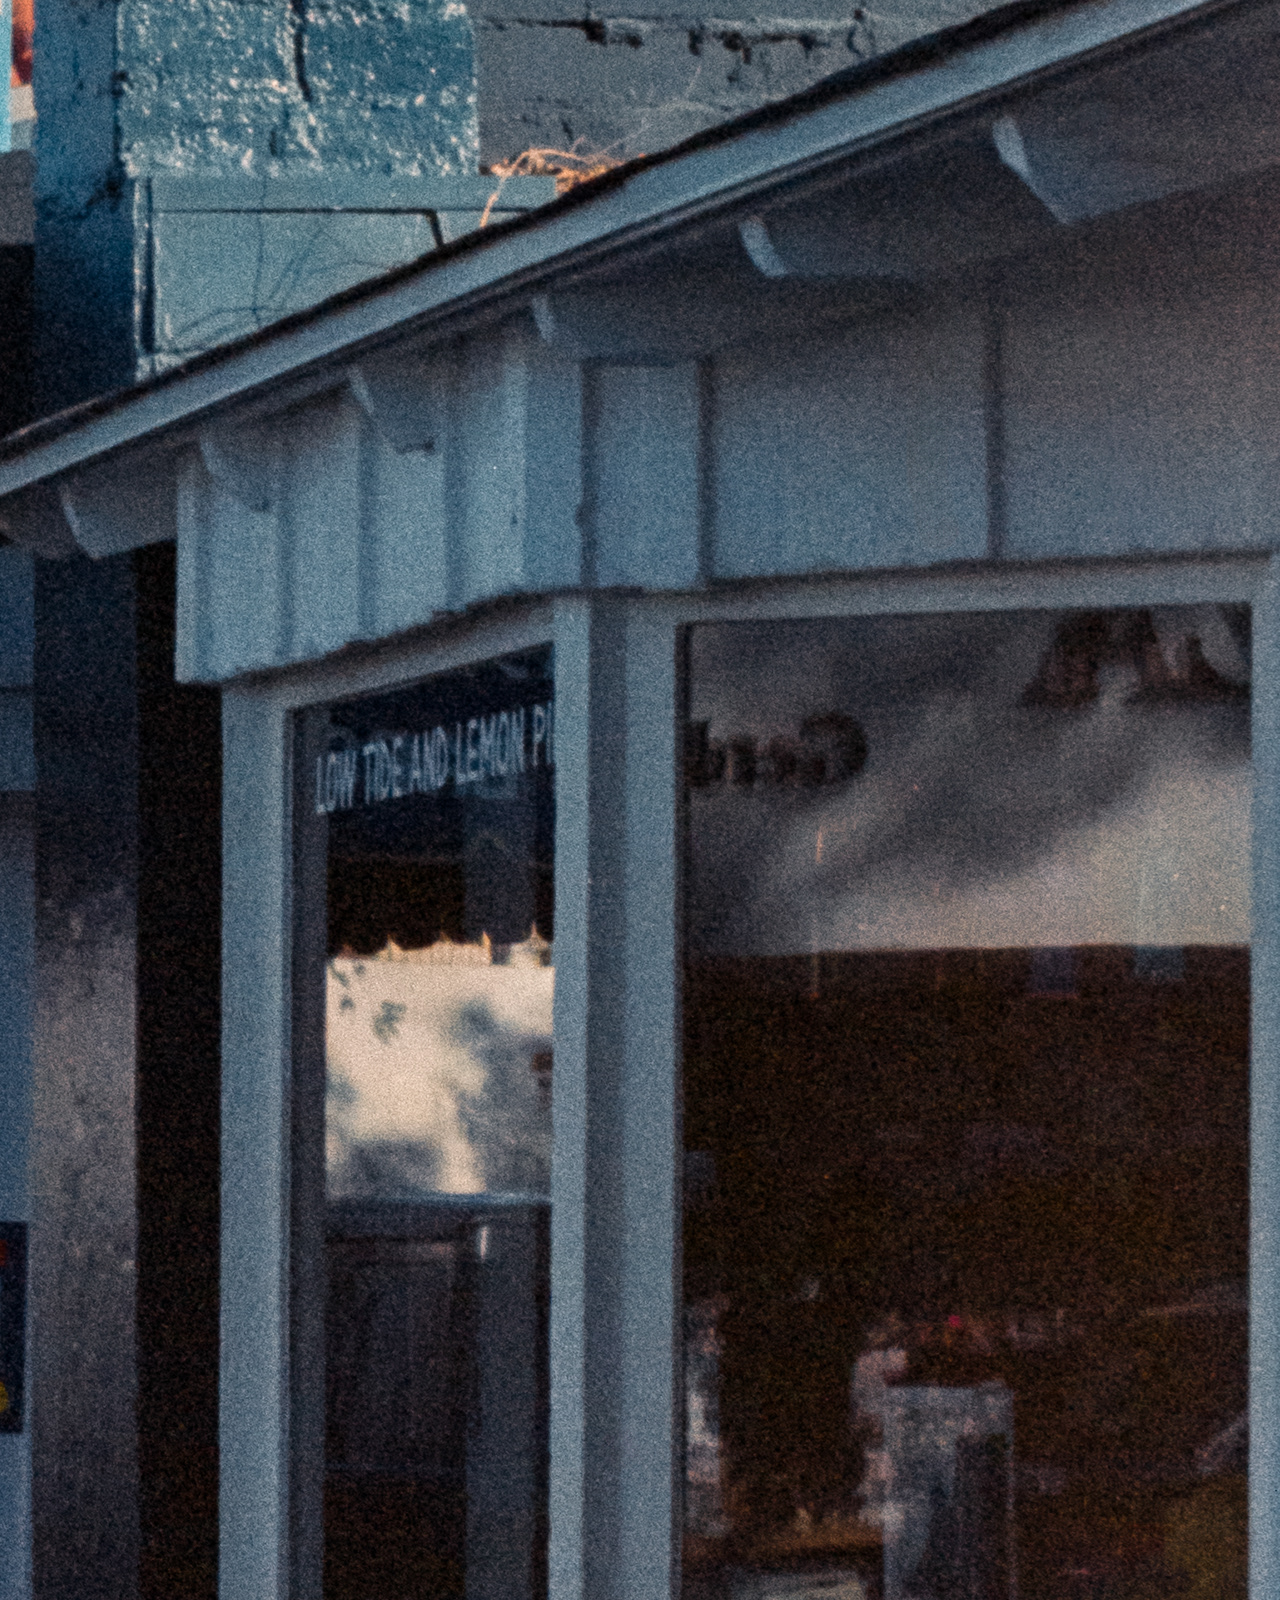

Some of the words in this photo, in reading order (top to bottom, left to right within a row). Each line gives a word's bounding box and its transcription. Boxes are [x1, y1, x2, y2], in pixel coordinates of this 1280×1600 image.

[315, 750, 357, 815] LOW
[362, 736, 407, 804] TIDE
[410, 726, 447, 791] AND
[455, 707, 525, 785] LEMON
